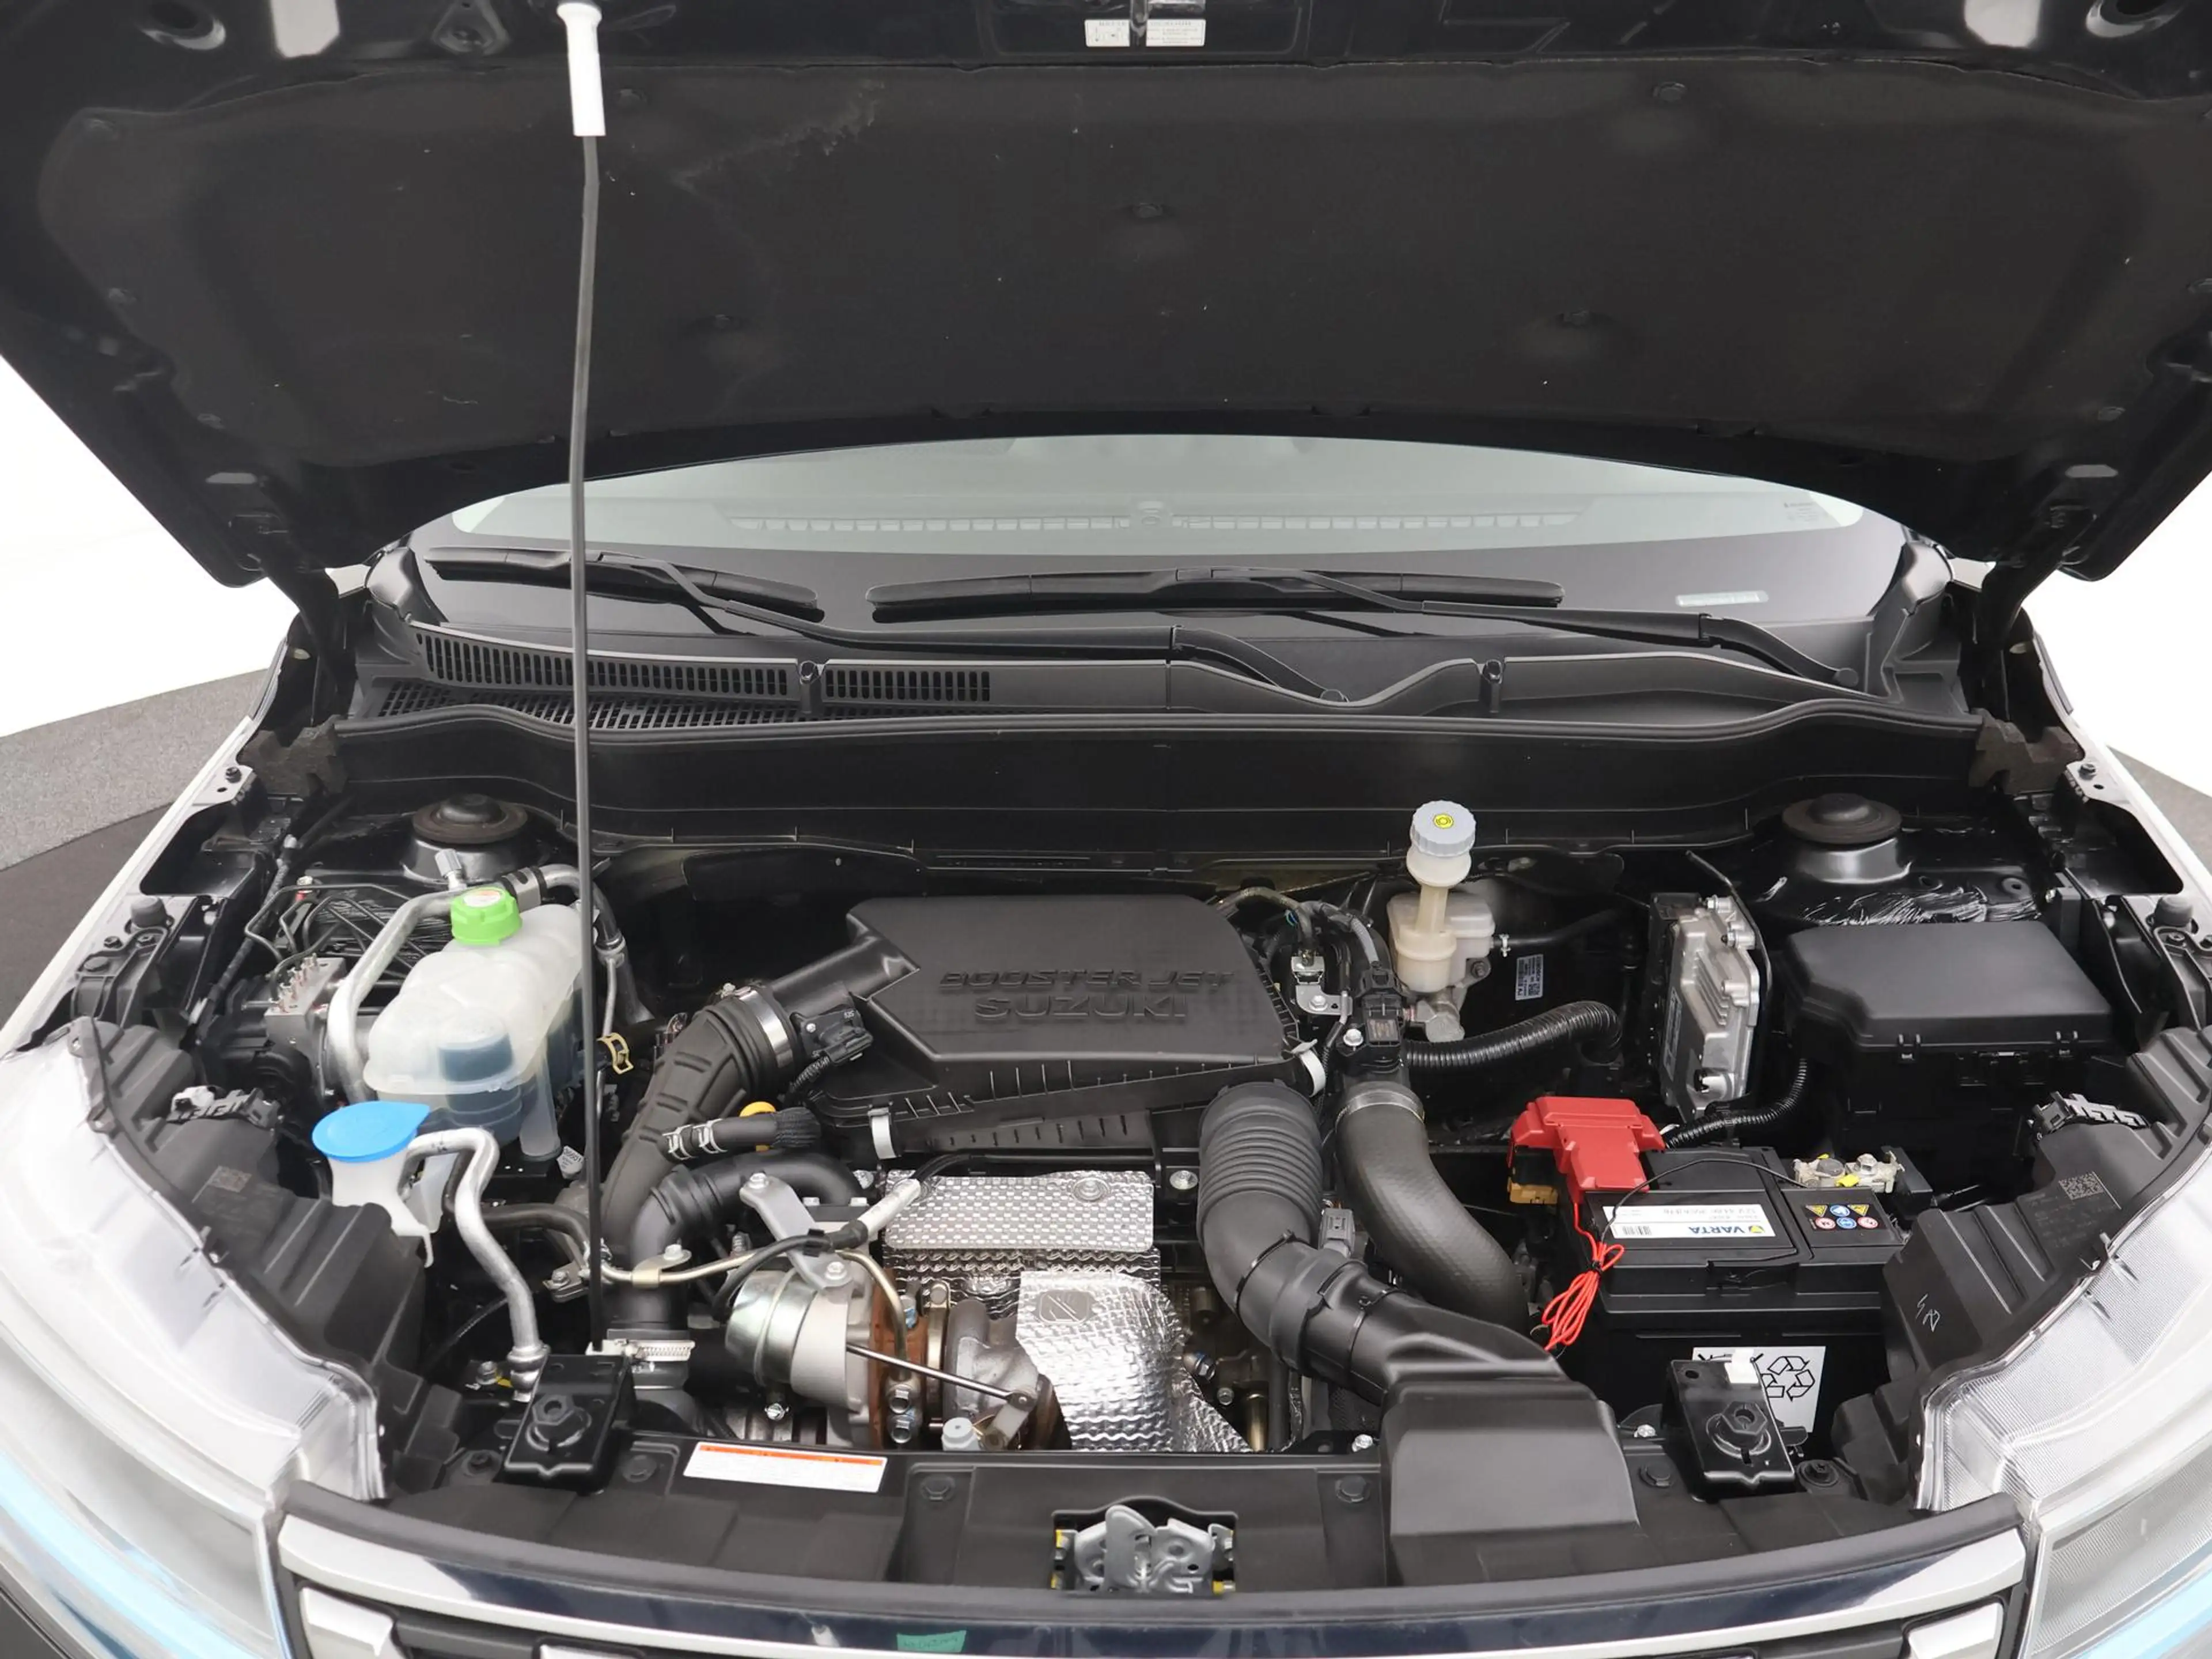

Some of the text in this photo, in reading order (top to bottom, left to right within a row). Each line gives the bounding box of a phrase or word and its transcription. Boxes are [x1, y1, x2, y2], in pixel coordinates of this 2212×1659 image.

[940, 969, 1237, 989] BOOSTER JET
[975, 994, 1188, 1018] SUZUKI
[1688, 1225, 1745, 1234] VARTA
